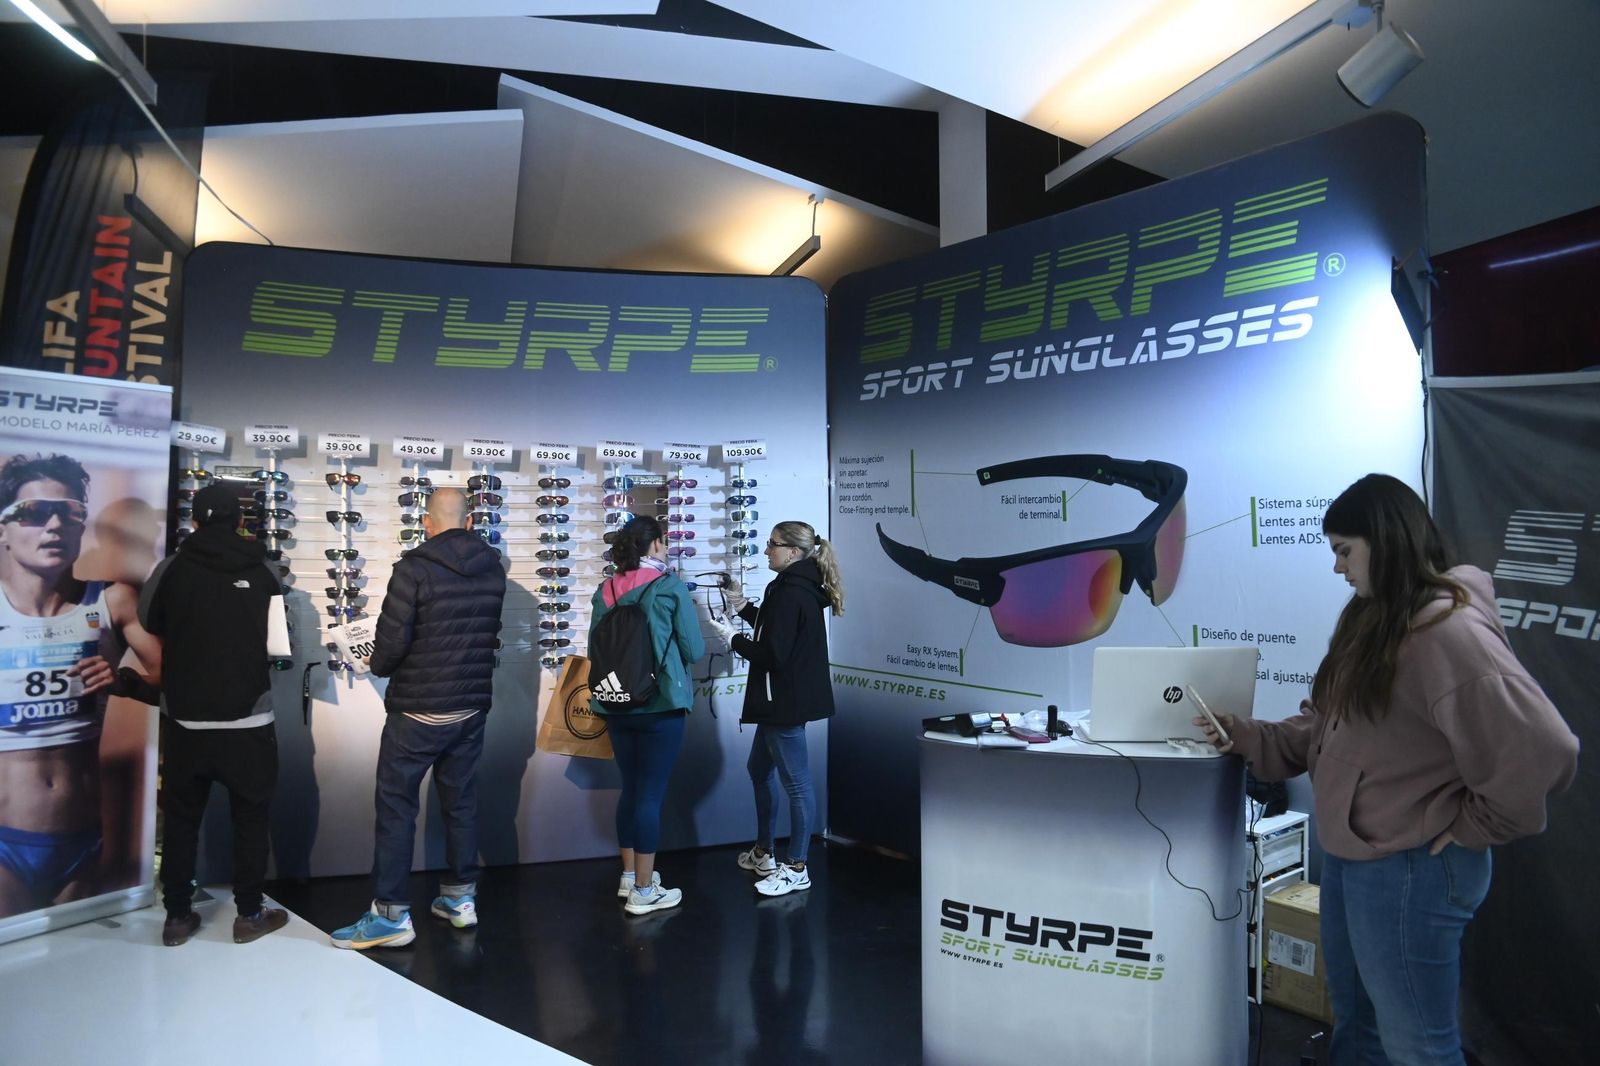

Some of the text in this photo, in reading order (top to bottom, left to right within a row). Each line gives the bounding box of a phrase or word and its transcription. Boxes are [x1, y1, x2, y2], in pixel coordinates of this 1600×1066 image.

[860, 177, 1329, 364] STYRPE
[241, 281, 770, 373] STYRPE
[860, 296, 1320, 401] SPORT SUNGLASSES
[66, 420, 113, 436] MARÍA
[177, 431, 217, 445] 29.90€
[253, 433, 291, 443] 39.90€
[326, 442, 363, 452] 39.90€
[400, 445, 437, 455] 49.90€
[470, 447, 506, 457] 59.90€
[727, 447, 763, 457] 109.90€
[536, 451, 571, 460] 69.90€
[603, 449, 637, 459] 69.90€
[669, 452, 702, 461] 79.90€
[839, 454, 884, 466] Máxima sujeción
[866, 480, 889, 489] terminal
[1001, 493, 1062, 505] Fácil intercambio
[1258, 498, 1302, 510] Sistema
[874, 504, 886, 514] end
[1019, 508, 1062, 520] de terminal.
[1260, 514, 1324, 527] Lentes anti
[1260, 533, 1325, 545] Lentes ADS.
[1496, 597, 1600, 641] SPO
[1201, 628, 1297, 645] Diseño de puente
[906, 644, 959, 659] Easy RX System.
[886, 654, 960, 673] Fácil cambio de lentes.
[25, 669, 69, 697] 85
[833, 673, 947, 701] WWW.STYRPE.ES
[1165, 687, 1183, 704] hp
[940, 899, 1154, 963] STYRPE
[941, 931, 1165, 981] SPORT SUNGLASSES
